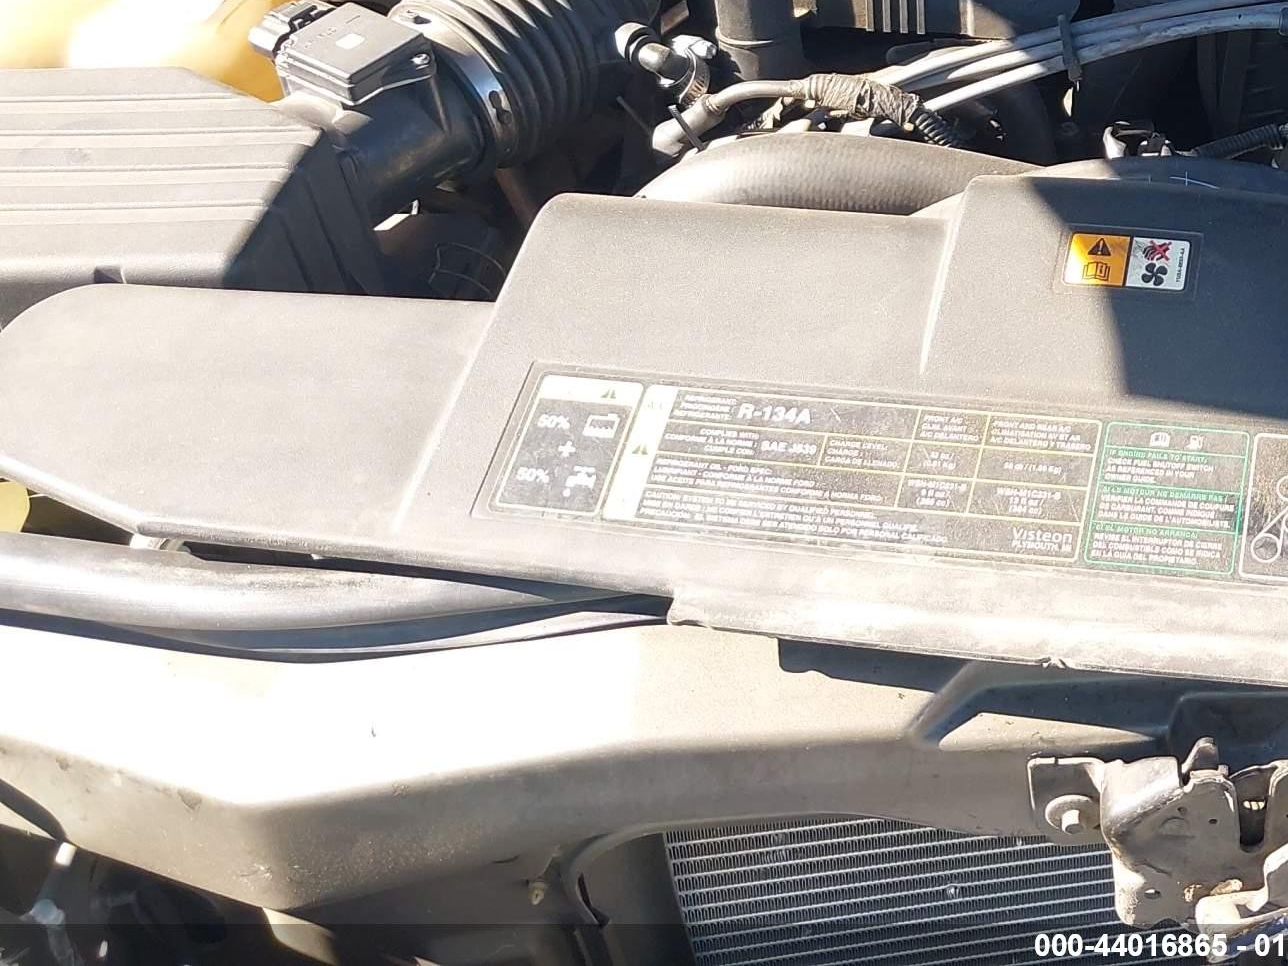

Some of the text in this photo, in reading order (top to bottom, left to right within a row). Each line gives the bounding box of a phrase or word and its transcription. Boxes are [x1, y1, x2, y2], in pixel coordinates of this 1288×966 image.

[536, 413, 573, 429] 50%
[735, 402, 813, 424] R-134A
[759, 440, 788, 452] SAE
[515, 466, 553, 483] 50%
[1011, 527, 1073, 544] Visteon
